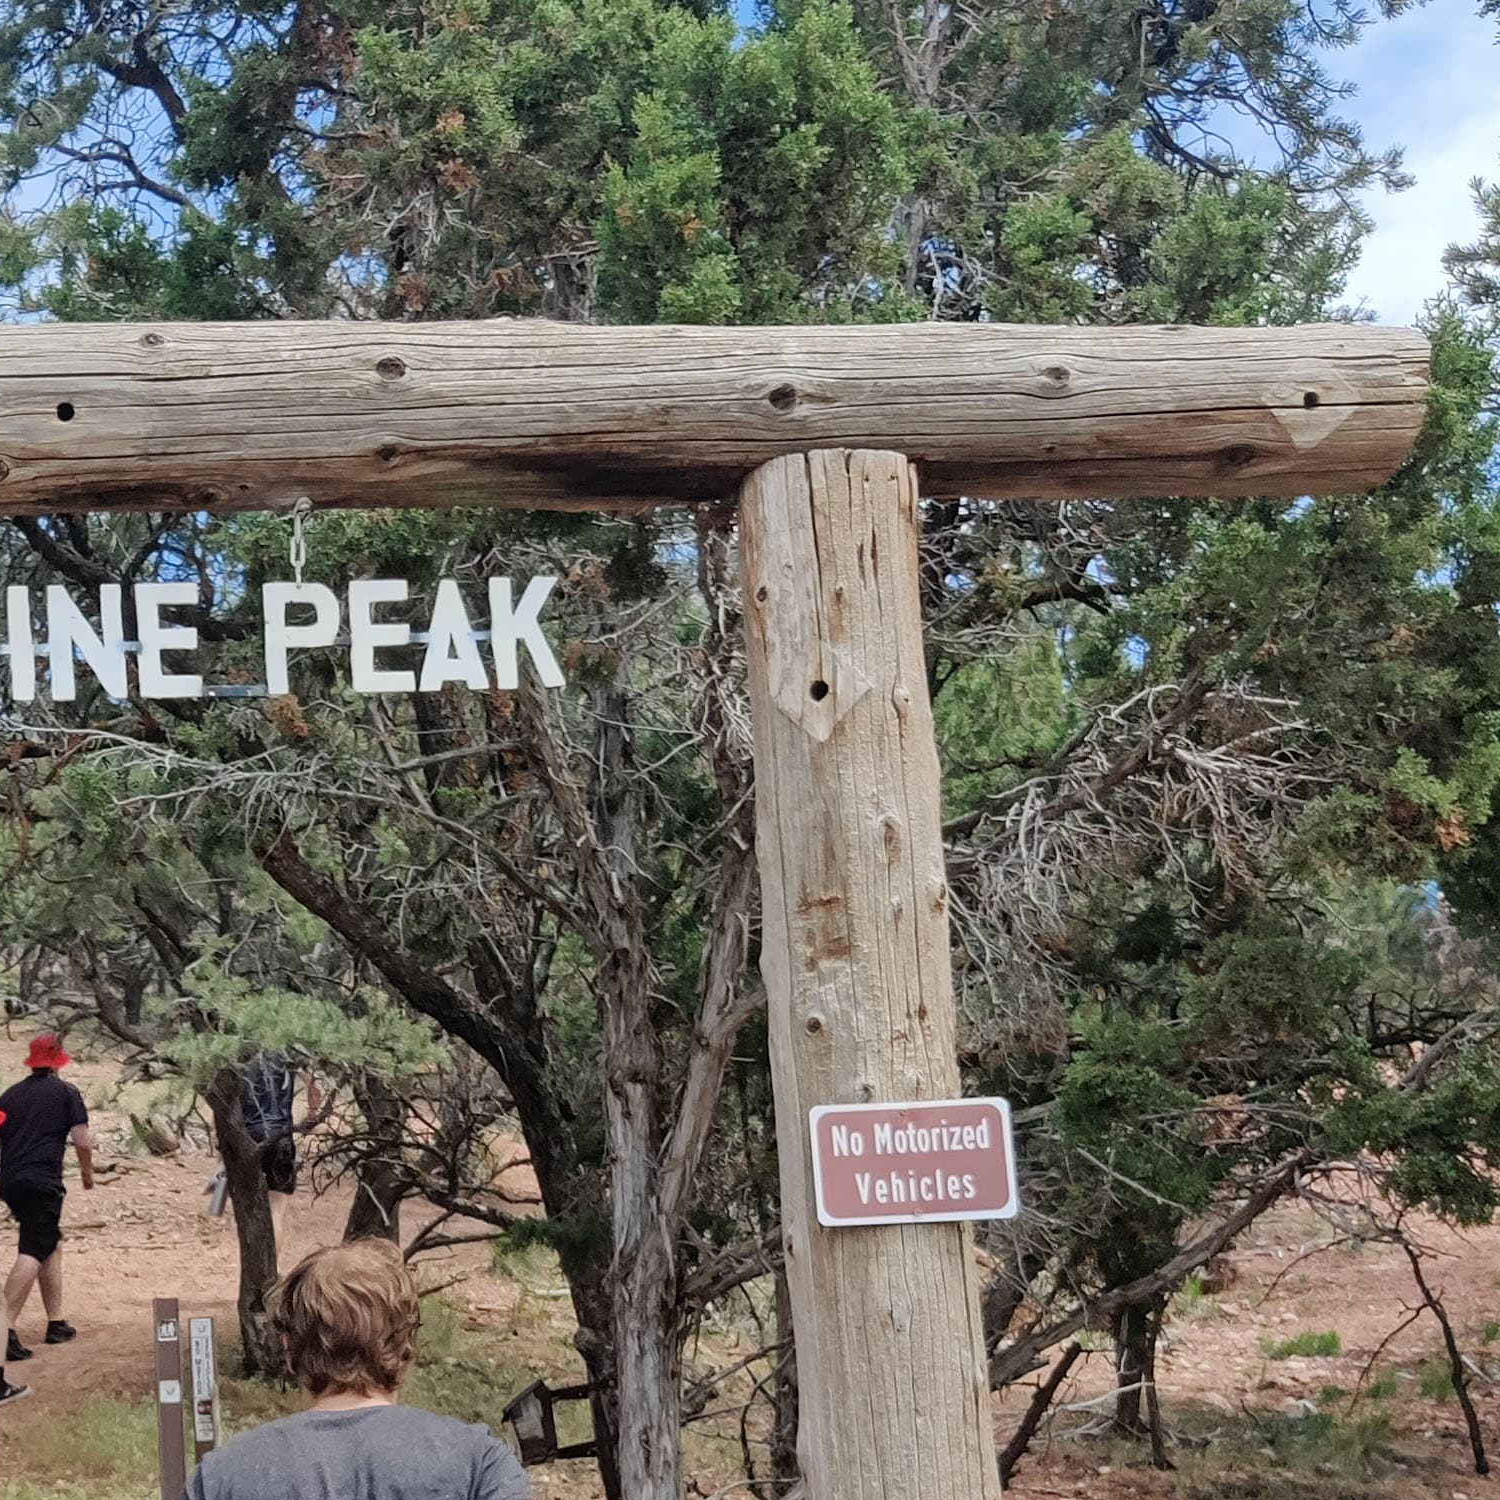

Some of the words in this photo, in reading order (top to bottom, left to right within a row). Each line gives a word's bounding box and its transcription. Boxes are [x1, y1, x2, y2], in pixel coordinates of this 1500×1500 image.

[262, 575, 567, 696] PEAK
[831, 1124, 864, 1157] No
[873, 1117, 991, 1156] Motorized
[854, 1168, 977, 1205] Vehicles
